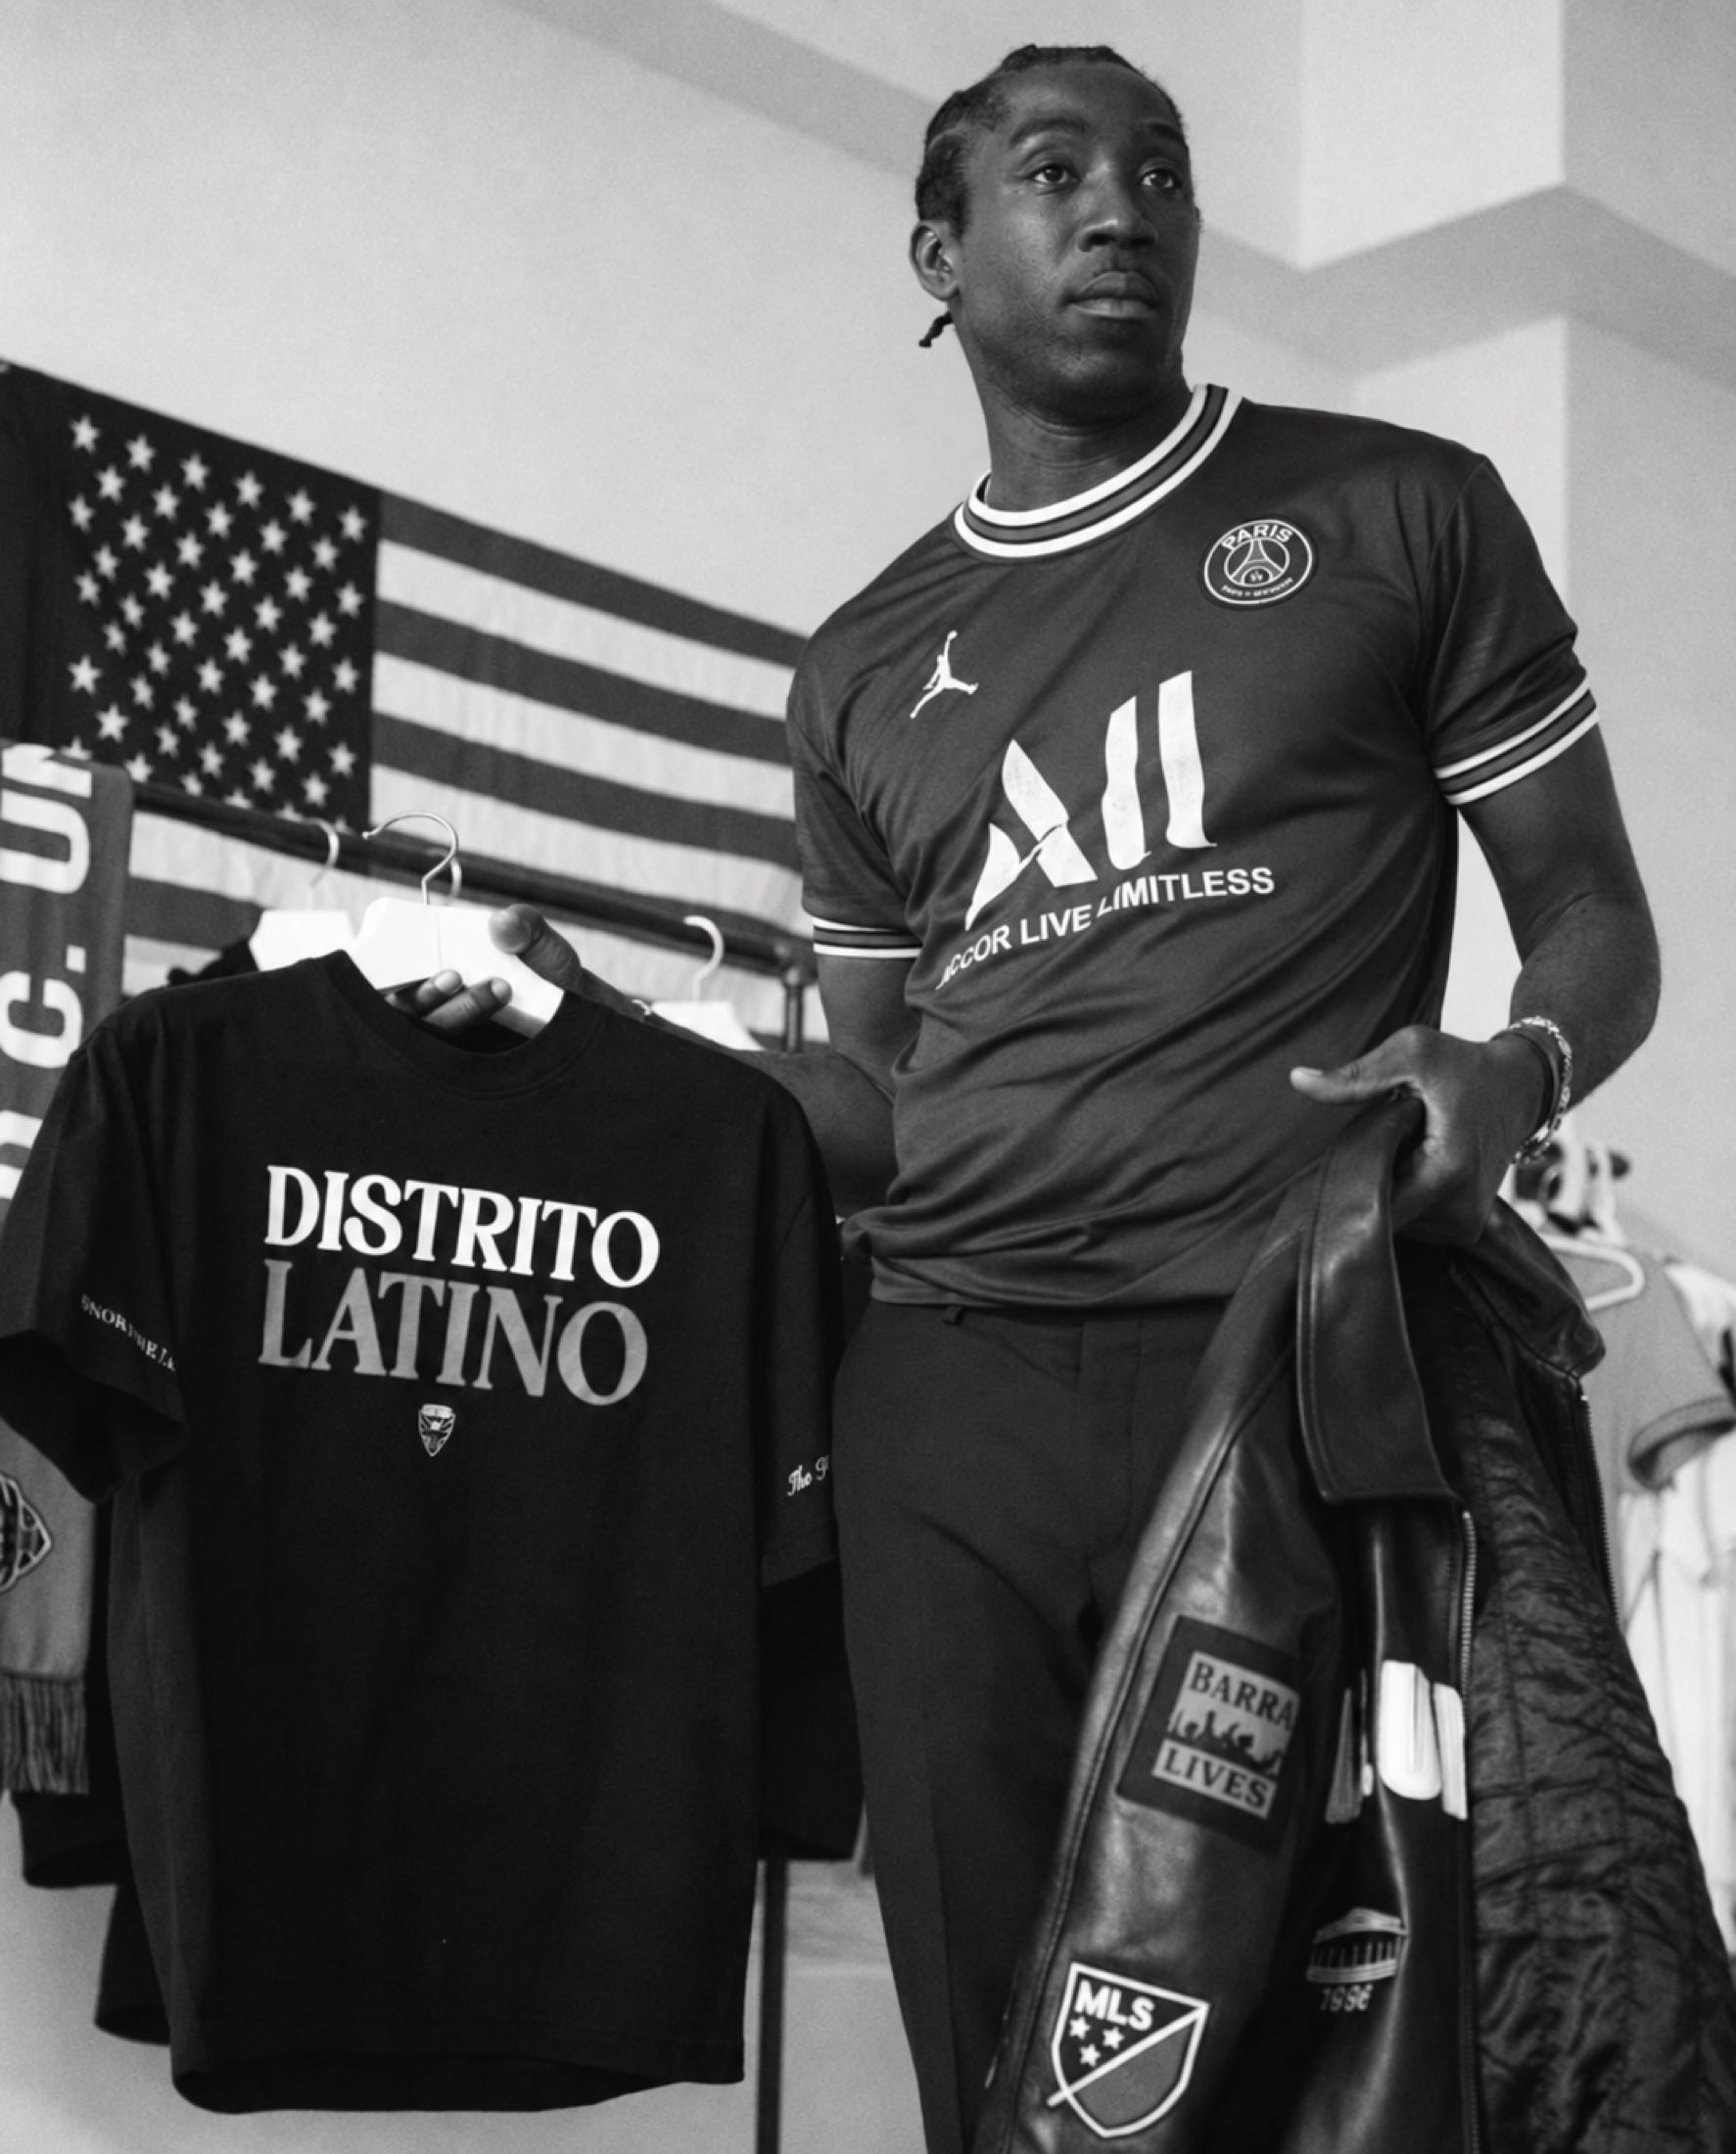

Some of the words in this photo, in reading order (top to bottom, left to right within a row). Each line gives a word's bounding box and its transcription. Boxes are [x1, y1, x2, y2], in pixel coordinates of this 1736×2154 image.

[1221, 524, 1293, 550] PARIS
[1020, 904, 1093, 945] LIVE
[1096, 866, 1275, 918] LIMITLESS
[264, 1164, 661, 1289] DISTRITO
[258, 1258, 649, 1406] LATINO
[1190, 1662, 1295, 1731] BARRA
[1164, 1746, 1269, 1806] LIVES
[1074, 1980, 1155, 2032] MLS
